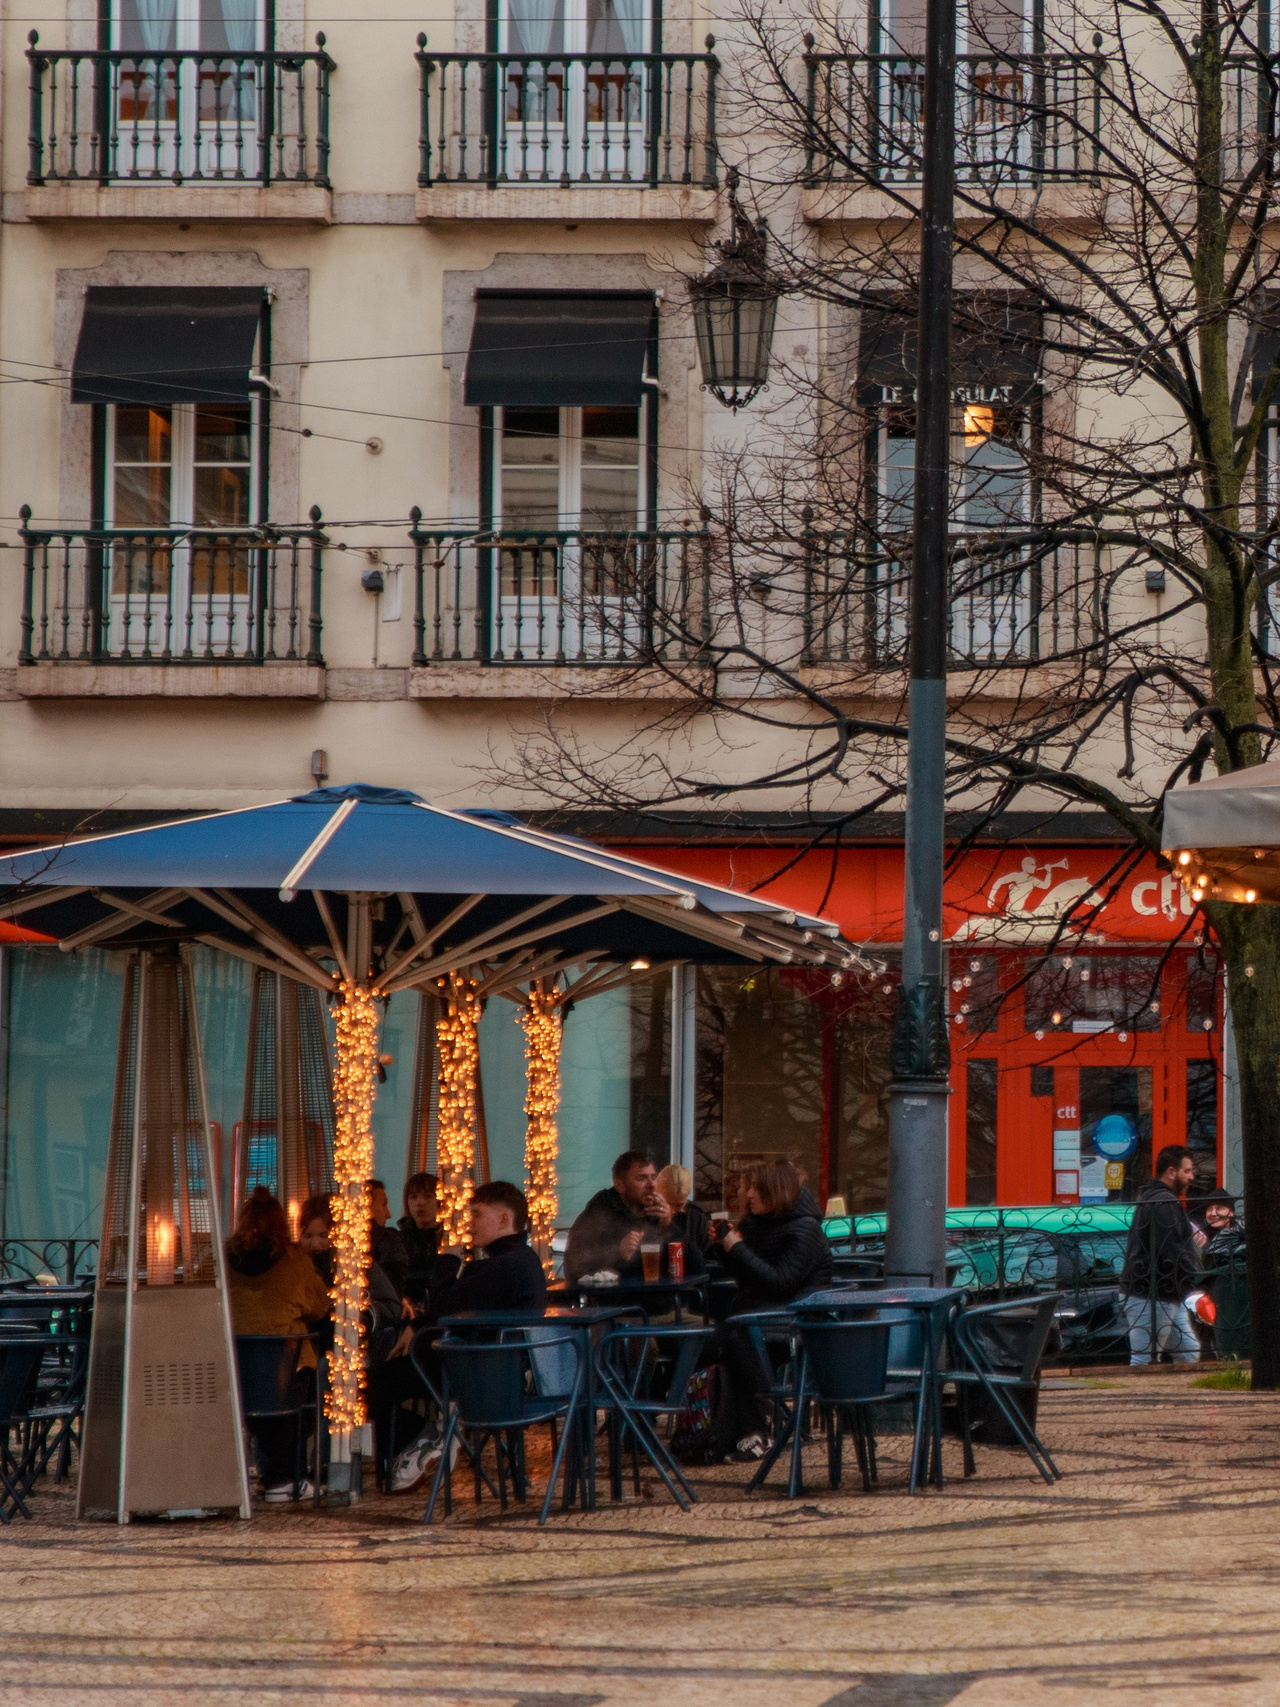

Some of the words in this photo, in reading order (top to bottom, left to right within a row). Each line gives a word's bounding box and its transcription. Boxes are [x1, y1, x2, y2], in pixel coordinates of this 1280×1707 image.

[882, 386, 903, 404] LE
[912, 385, 1013, 404] SULAT
[1056, 1105, 1077, 1119] ctt
